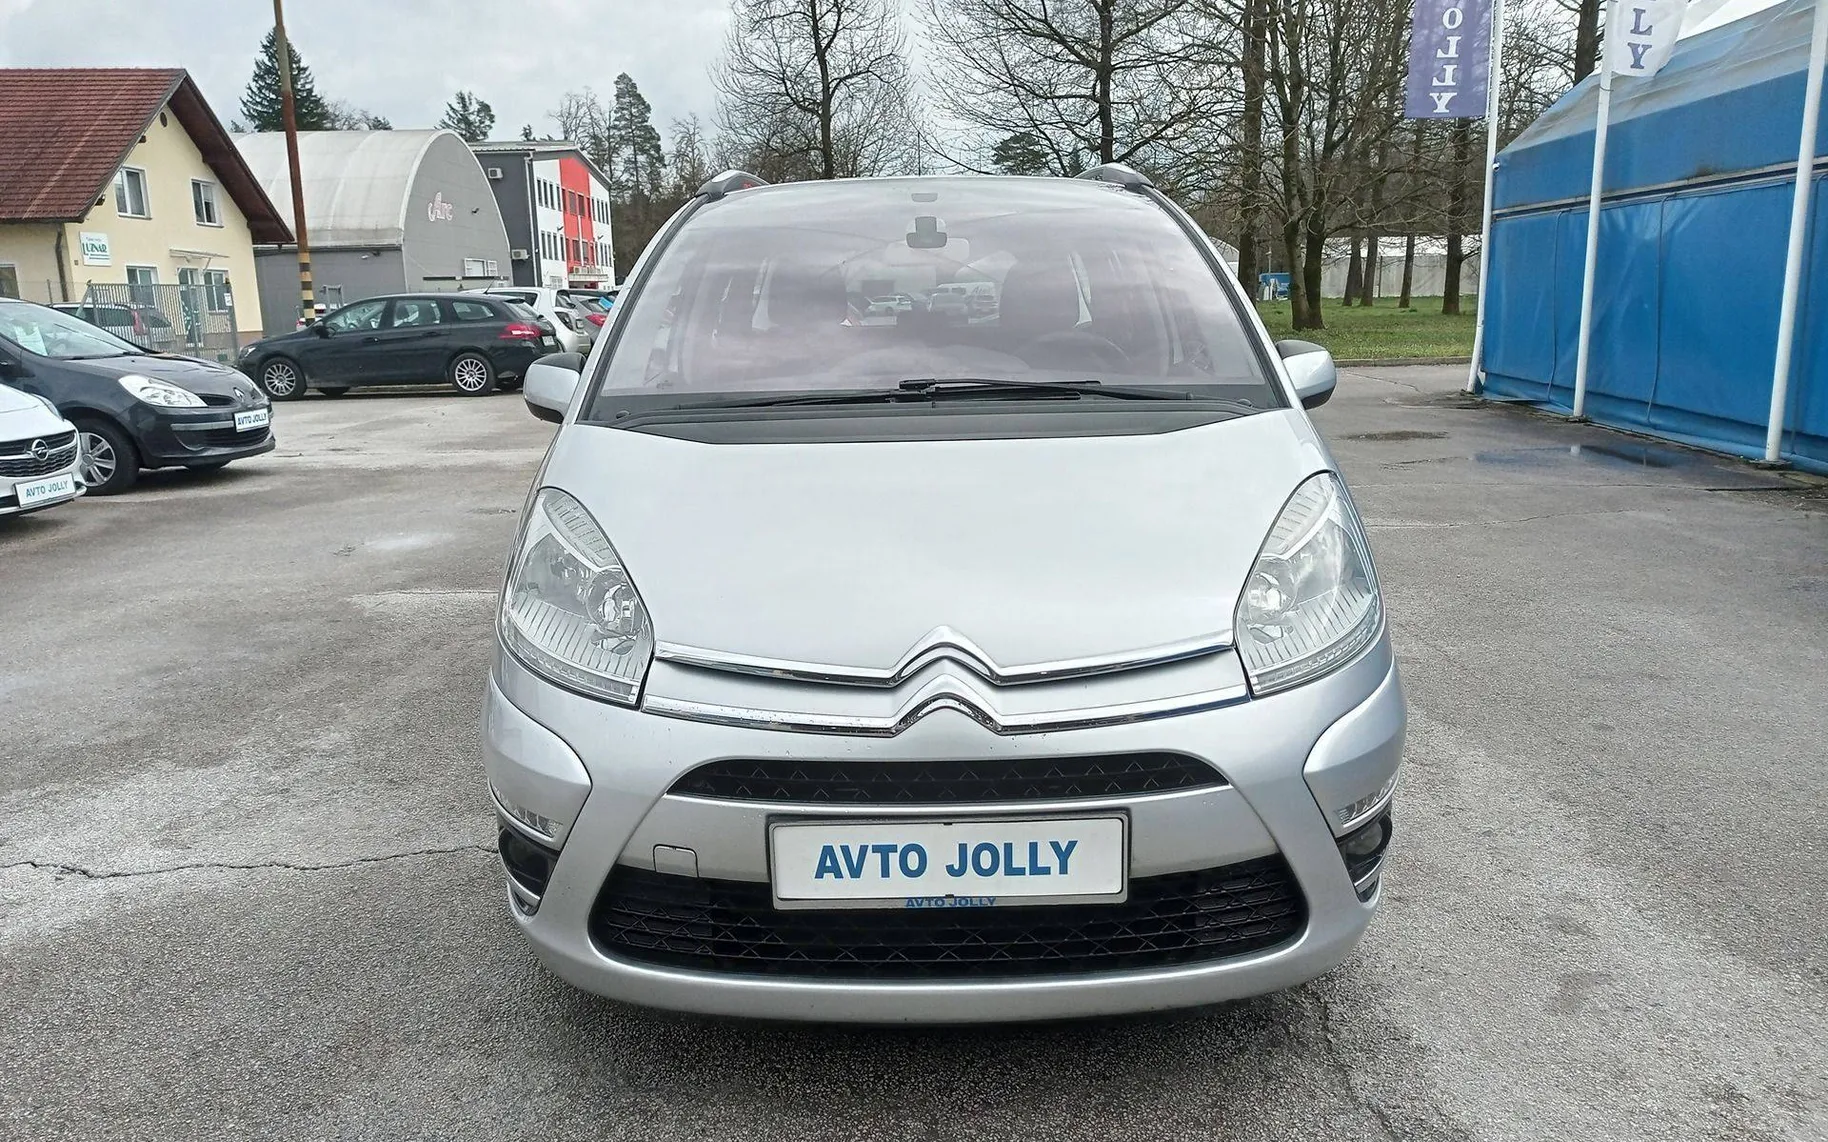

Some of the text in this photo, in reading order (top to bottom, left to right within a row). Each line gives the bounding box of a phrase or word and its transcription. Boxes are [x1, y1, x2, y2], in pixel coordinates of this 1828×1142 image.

[26, 480, 68, 498] AVTO JOLLY
[814, 840, 1079, 880] AVTO JOLLY
[906, 896, 996, 908] AVTO JOLLY
